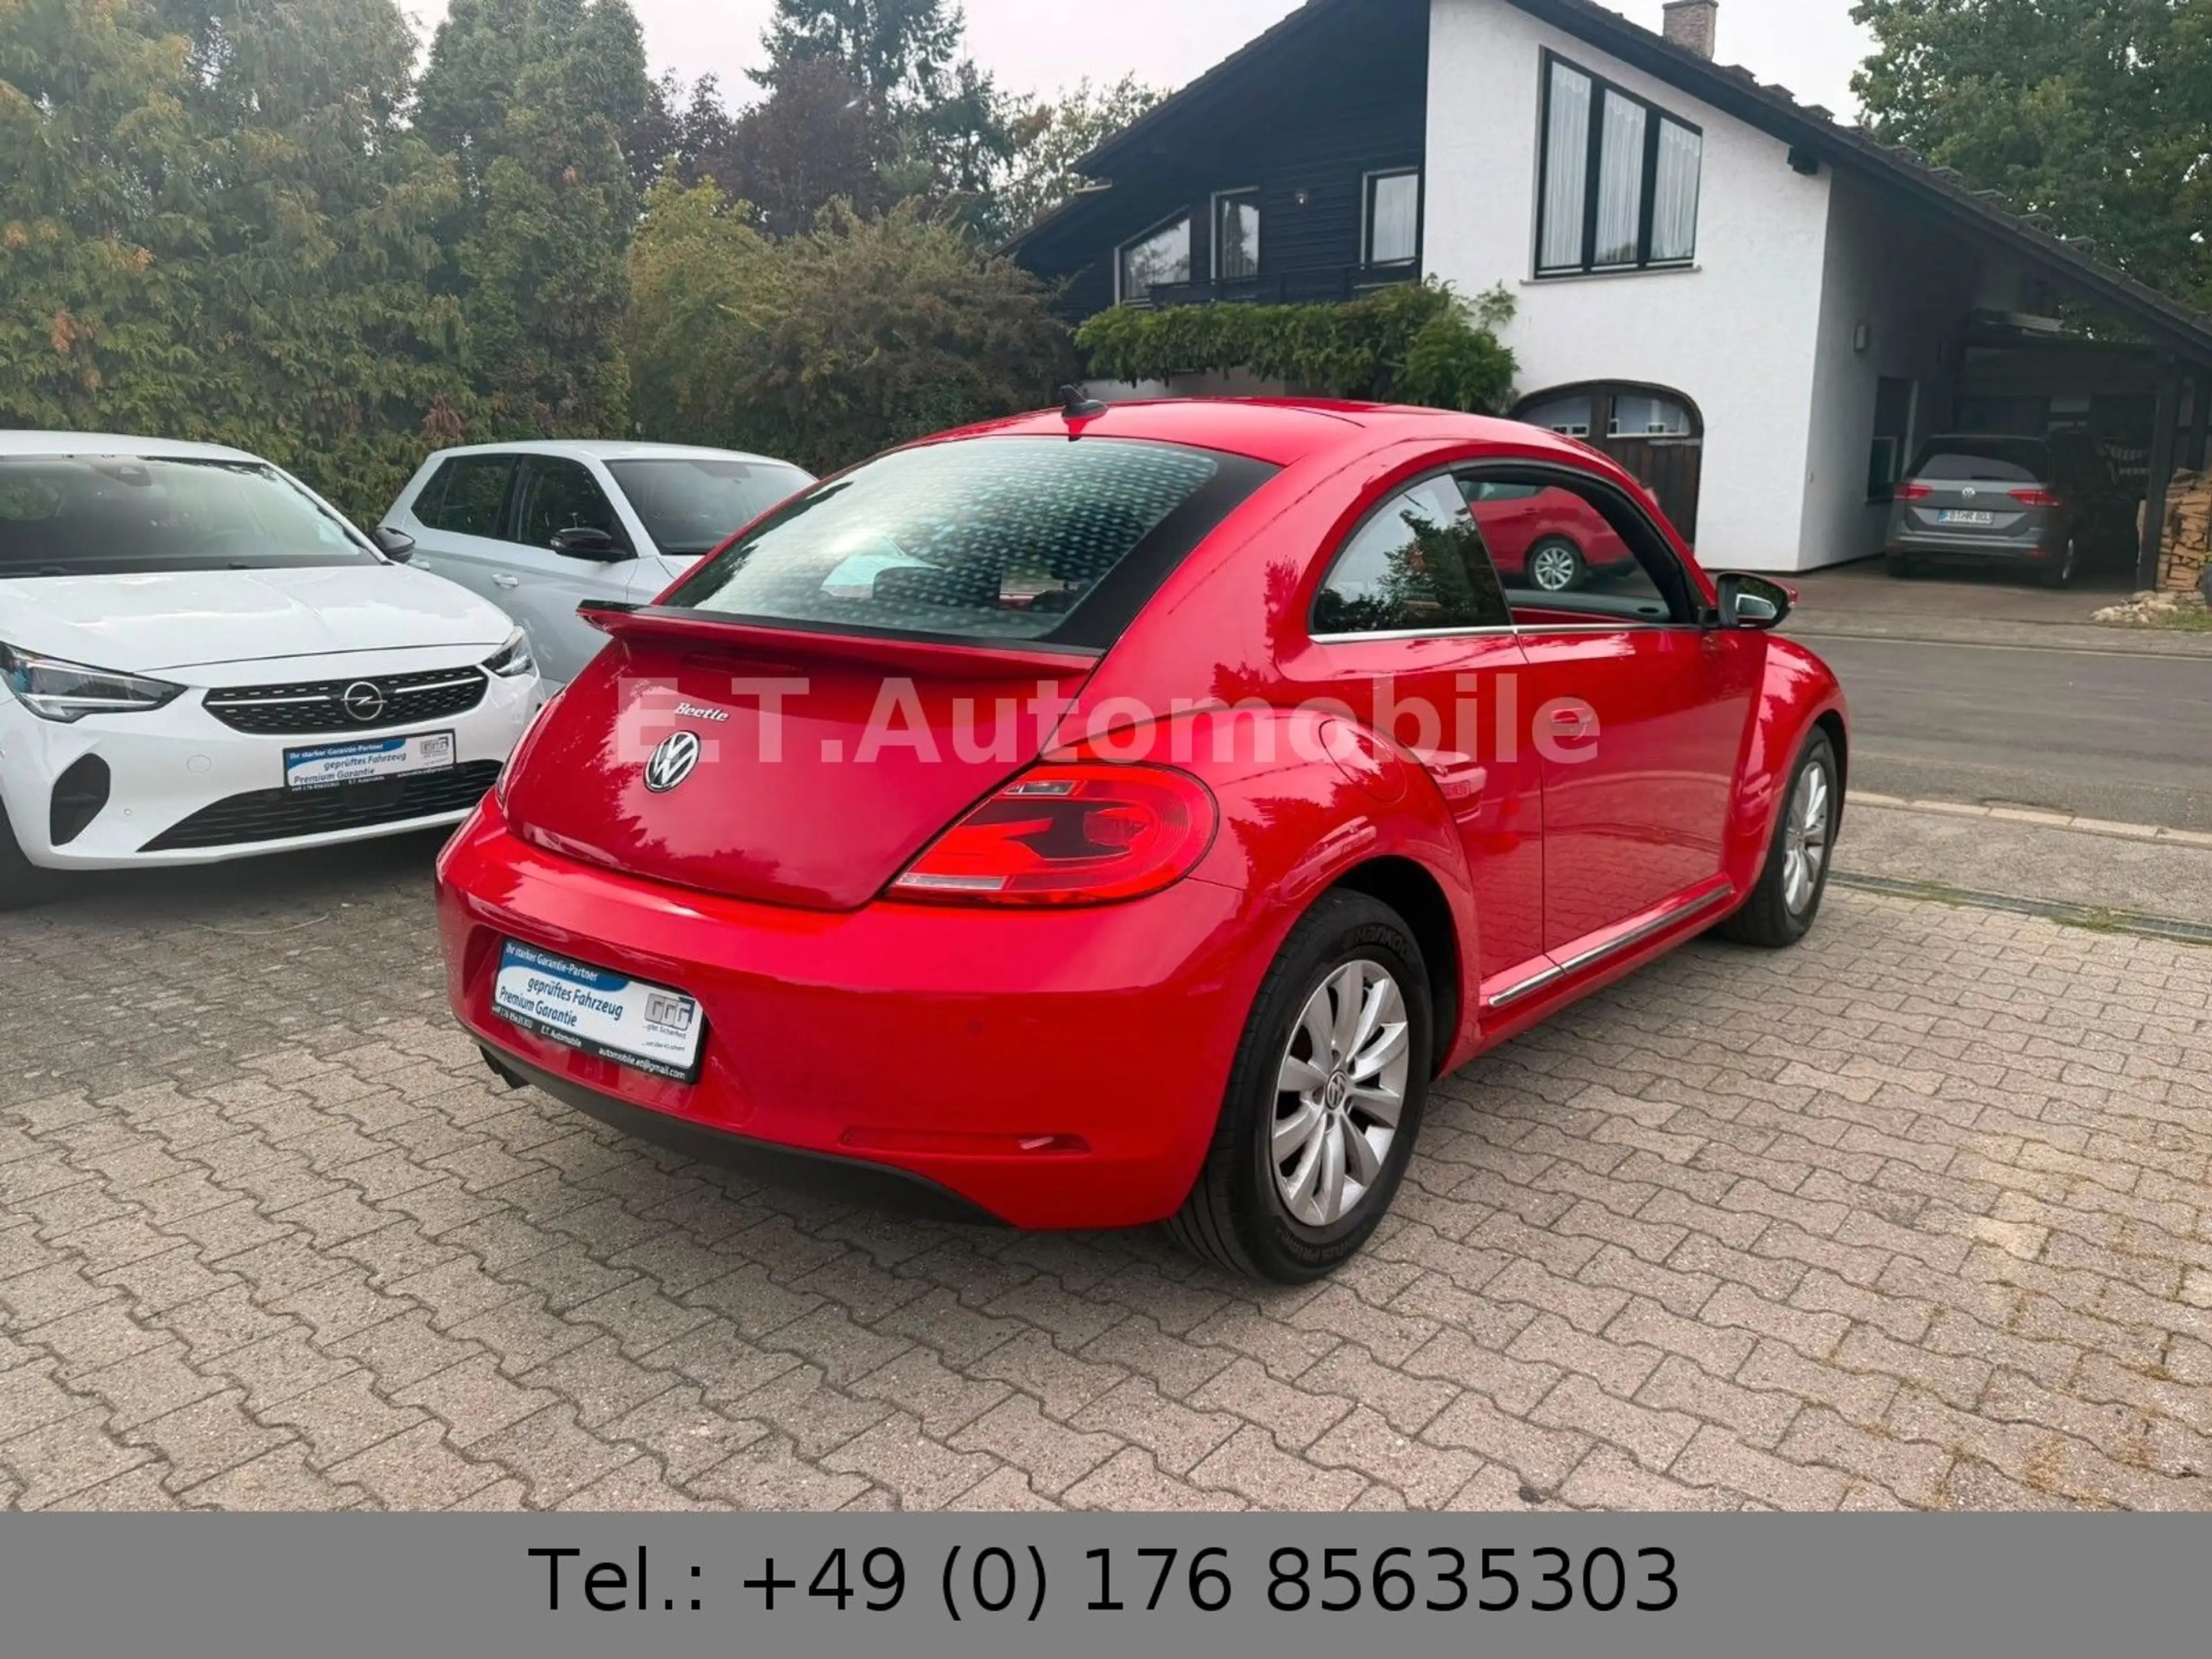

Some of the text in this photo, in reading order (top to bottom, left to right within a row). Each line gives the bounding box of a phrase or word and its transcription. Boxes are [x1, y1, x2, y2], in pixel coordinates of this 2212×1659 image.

[674, 702, 730, 722] Beetle
[323, 757, 366, 771] geprüftes
[368, 753, 407, 764] Fahrzeug
[294, 767, 376, 784] Premium Garantie
[537, 953, 599, 982] Garantie-Partner
[499, 986, 535, 1012] Premium
[535, 1001, 578, 1027] Garantie
[527, 978, 623, 1021] geprüftes Fahrzeug
